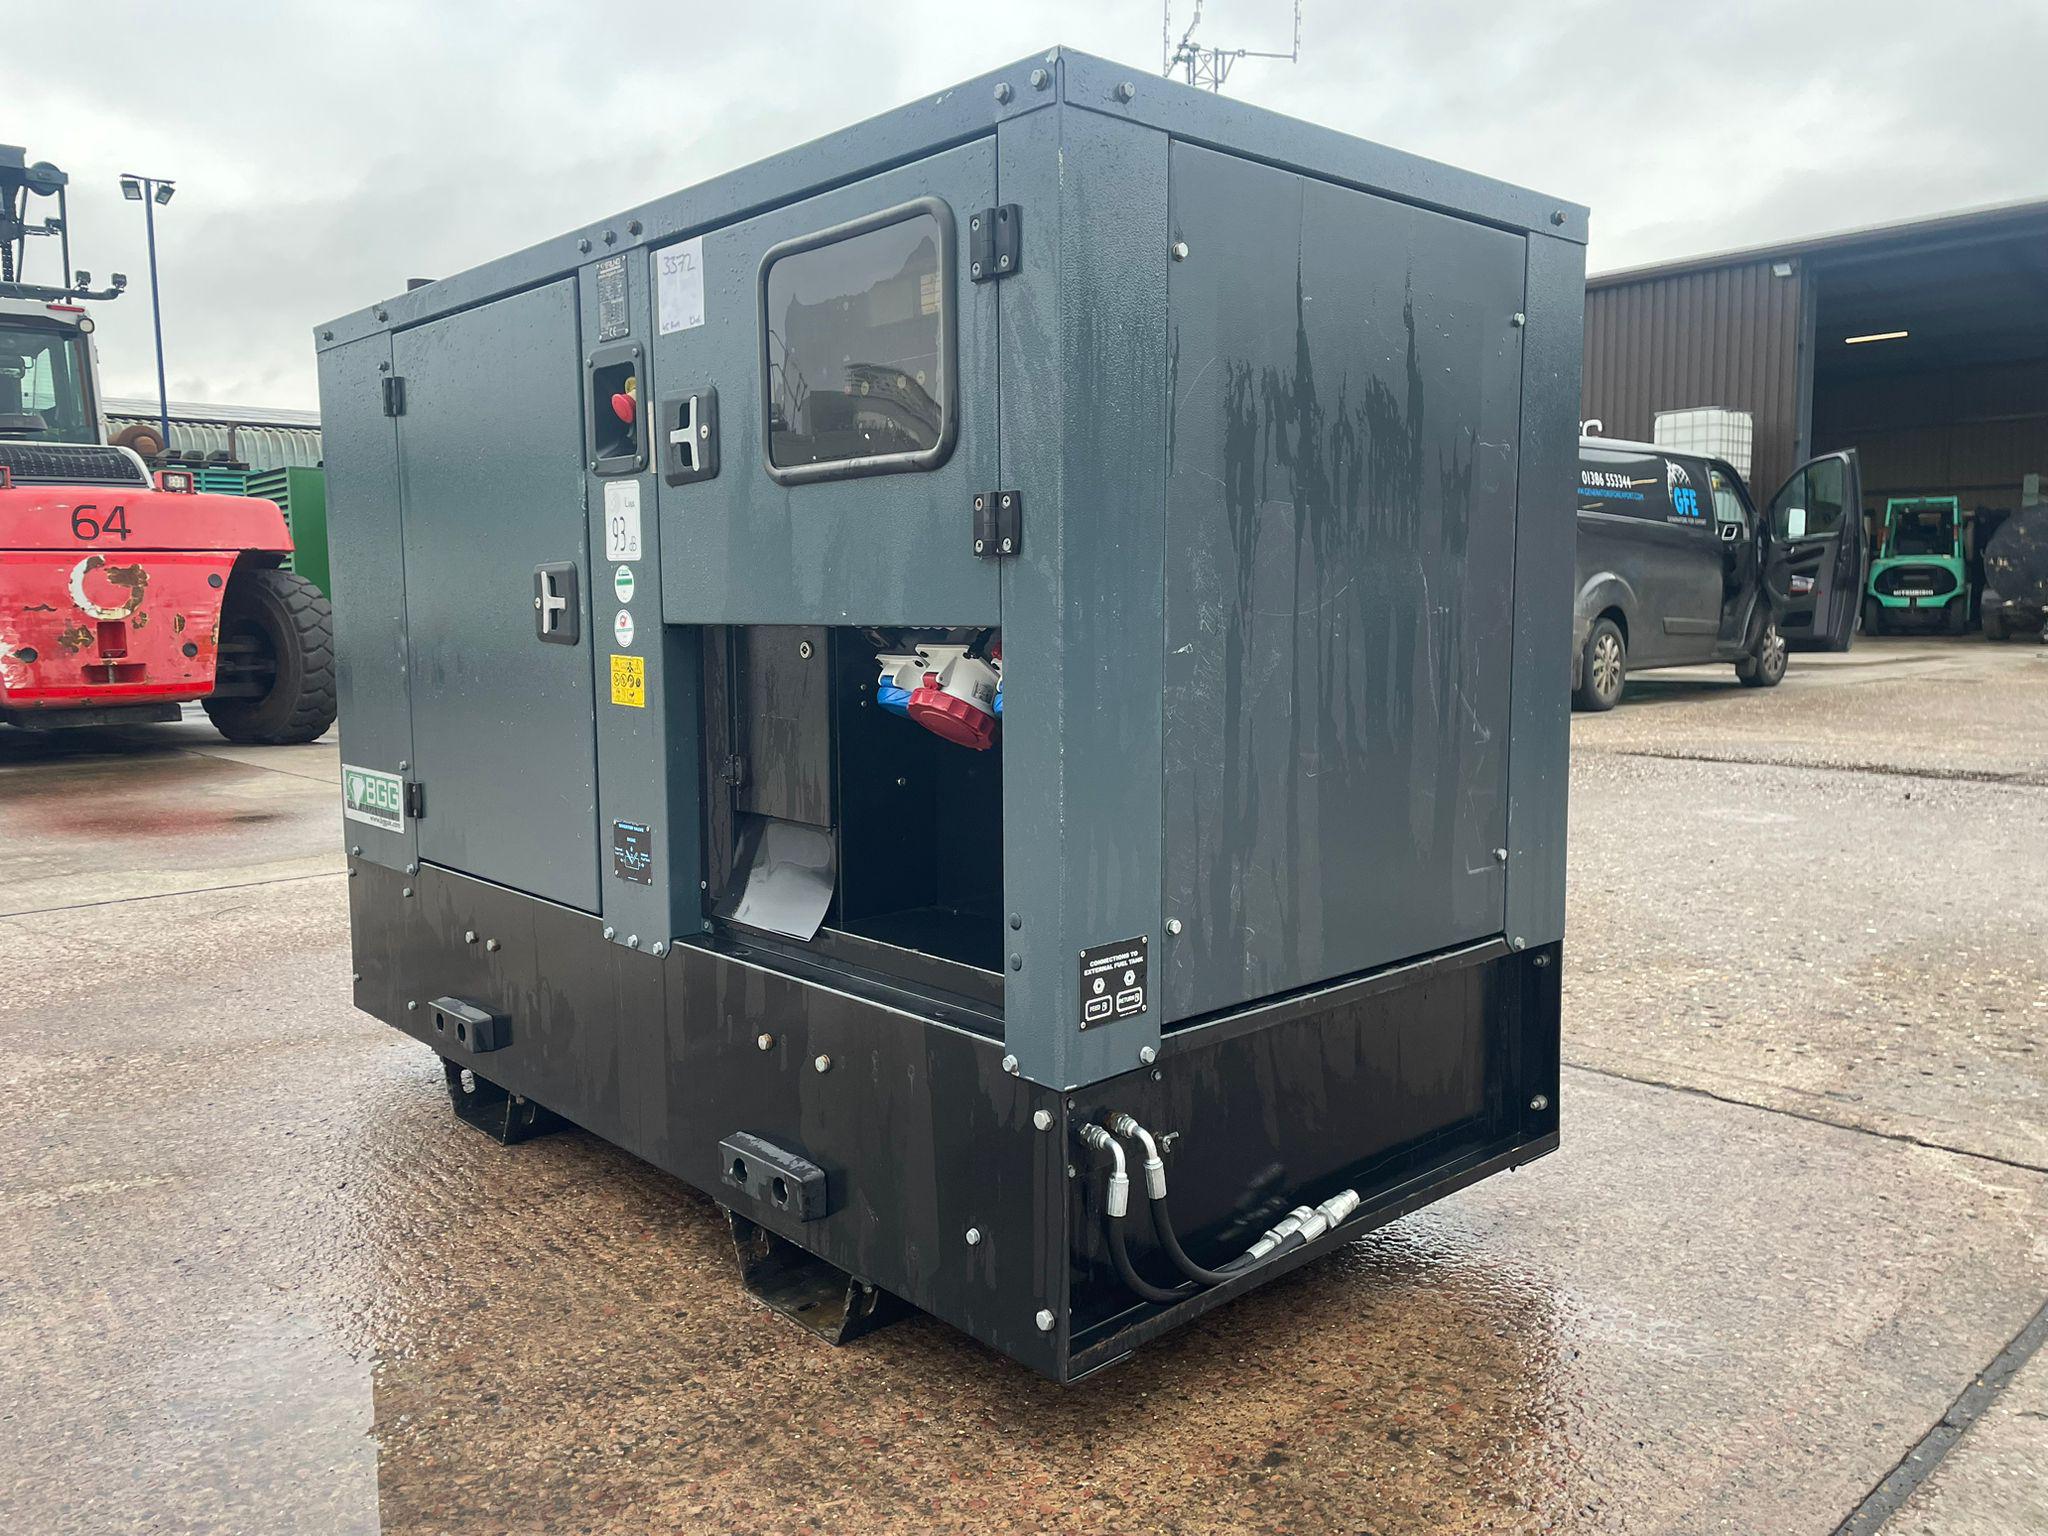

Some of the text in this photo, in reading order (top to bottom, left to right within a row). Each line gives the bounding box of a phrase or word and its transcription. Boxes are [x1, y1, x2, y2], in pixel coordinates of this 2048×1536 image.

[1581, 470, 1631, 489] 01386 553344
[1673, 487, 1700, 517] GFE
[71, 504, 132, 541] 64
[612, 516, 626, 552] 93
[365, 777, 400, 811] BGG
[1083, 956, 1143, 976] EXTERNAL FUEL TANK
[1089, 952, 1130, 967] CONNECTIONS
